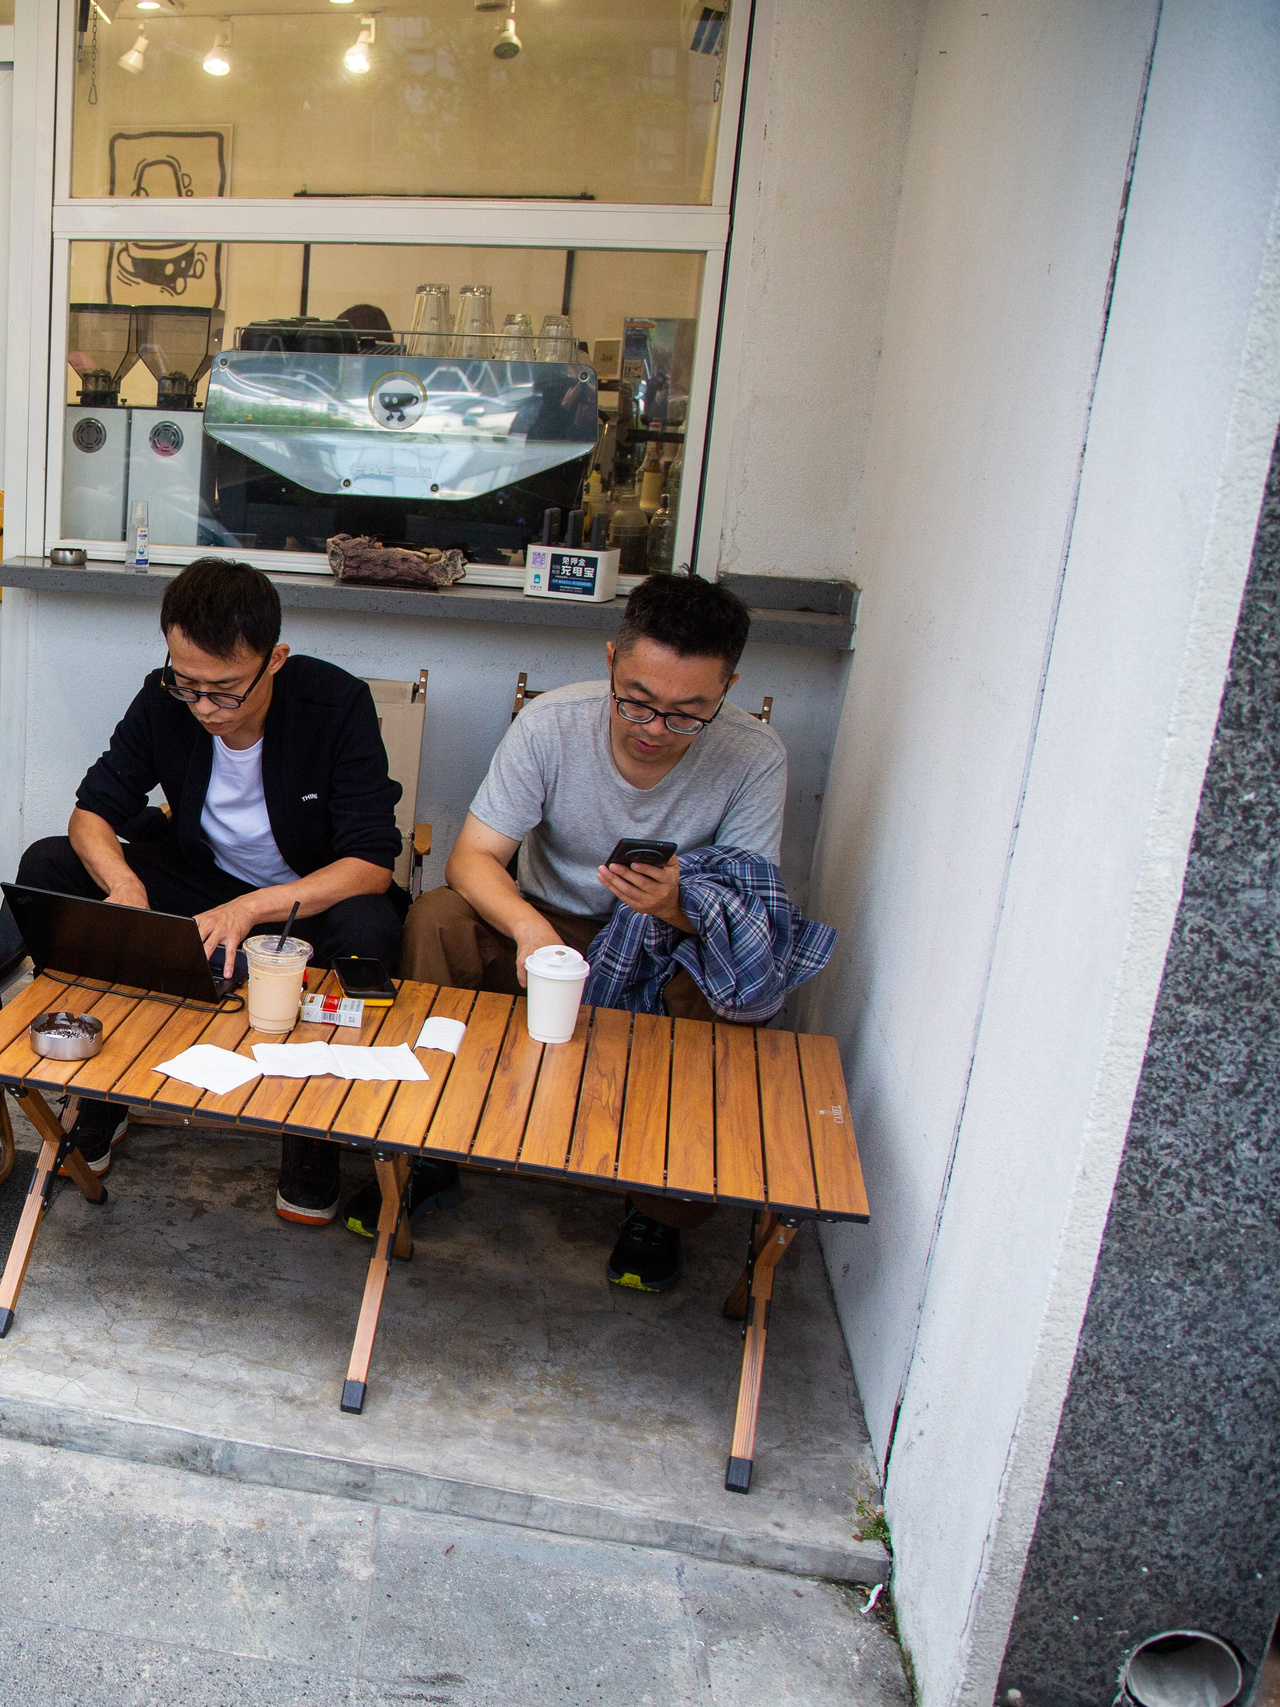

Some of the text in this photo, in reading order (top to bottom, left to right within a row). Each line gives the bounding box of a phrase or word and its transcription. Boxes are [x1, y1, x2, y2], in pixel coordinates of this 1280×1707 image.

[562, 556, 587, 567] 免押金
[561, 565, 595, 578] 充电宝
